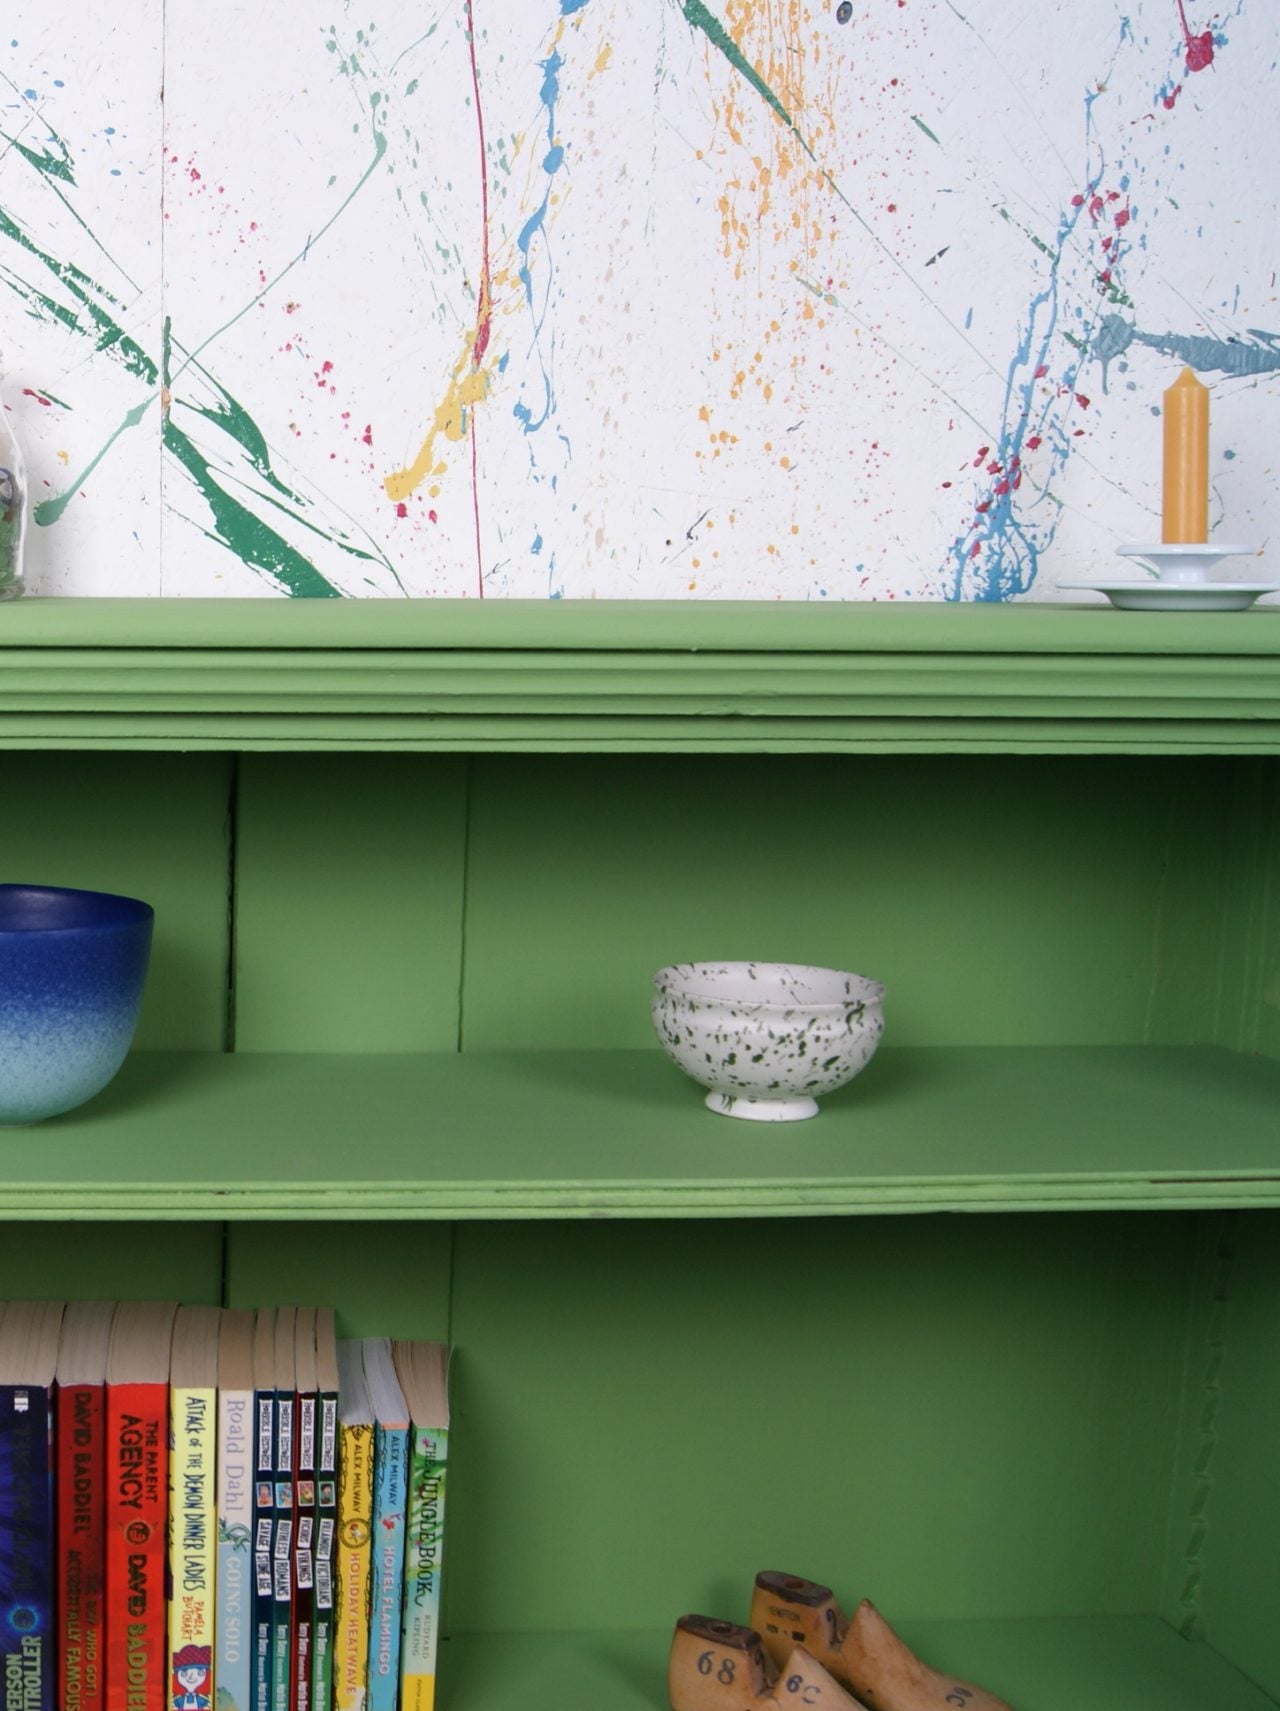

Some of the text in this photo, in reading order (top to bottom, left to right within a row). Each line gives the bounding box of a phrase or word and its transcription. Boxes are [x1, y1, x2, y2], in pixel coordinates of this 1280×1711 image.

[73, 1391, 93, 1535] DAVID BADDIEL
[119, 1414, 144, 1509] AGENCY
[145, 1421, 159, 1502] THE PARENT
[187, 1453, 202, 1469] THE
[225, 1400, 246, 1512] Roald Dahl
[352, 1444, 363, 1513] ALEX MILWAY
[389, 1436, 400, 1506] ALEX MILWAY
[182, 1473, 206, 1509] DEMON
[183, 1513, 207, 1550] DINNER
[258, 1521, 270, 1547] SAVAGE
[277, 1522, 290, 1555] RUTHLESS
[415, 1442, 441, 1607] THE JUNGLE BOOK
[127, 1553, 148, 1616] DAVID
[183, 1554, 206, 1591] LADIES
[275, 1562, 289, 1597] ROMANS
[297, 1551, 311, 1583] VIKINGS
[317, 1563, 330, 1604] VICTORIANS
[181, 1595, 194, 1640] BUTCHART
[195, 1601, 205, 1635] PAMELA
[225, 1556, 241, 1662] GOING SOLO
[346, 1553, 361, 1695] HOLIDAY HEATWAVE
[378, 1546, 395, 1676] HOTEL FLAMINGO
[86, 1630, 97, 1660] WHO
[422, 1614, 431, 1659] RUDYARD
